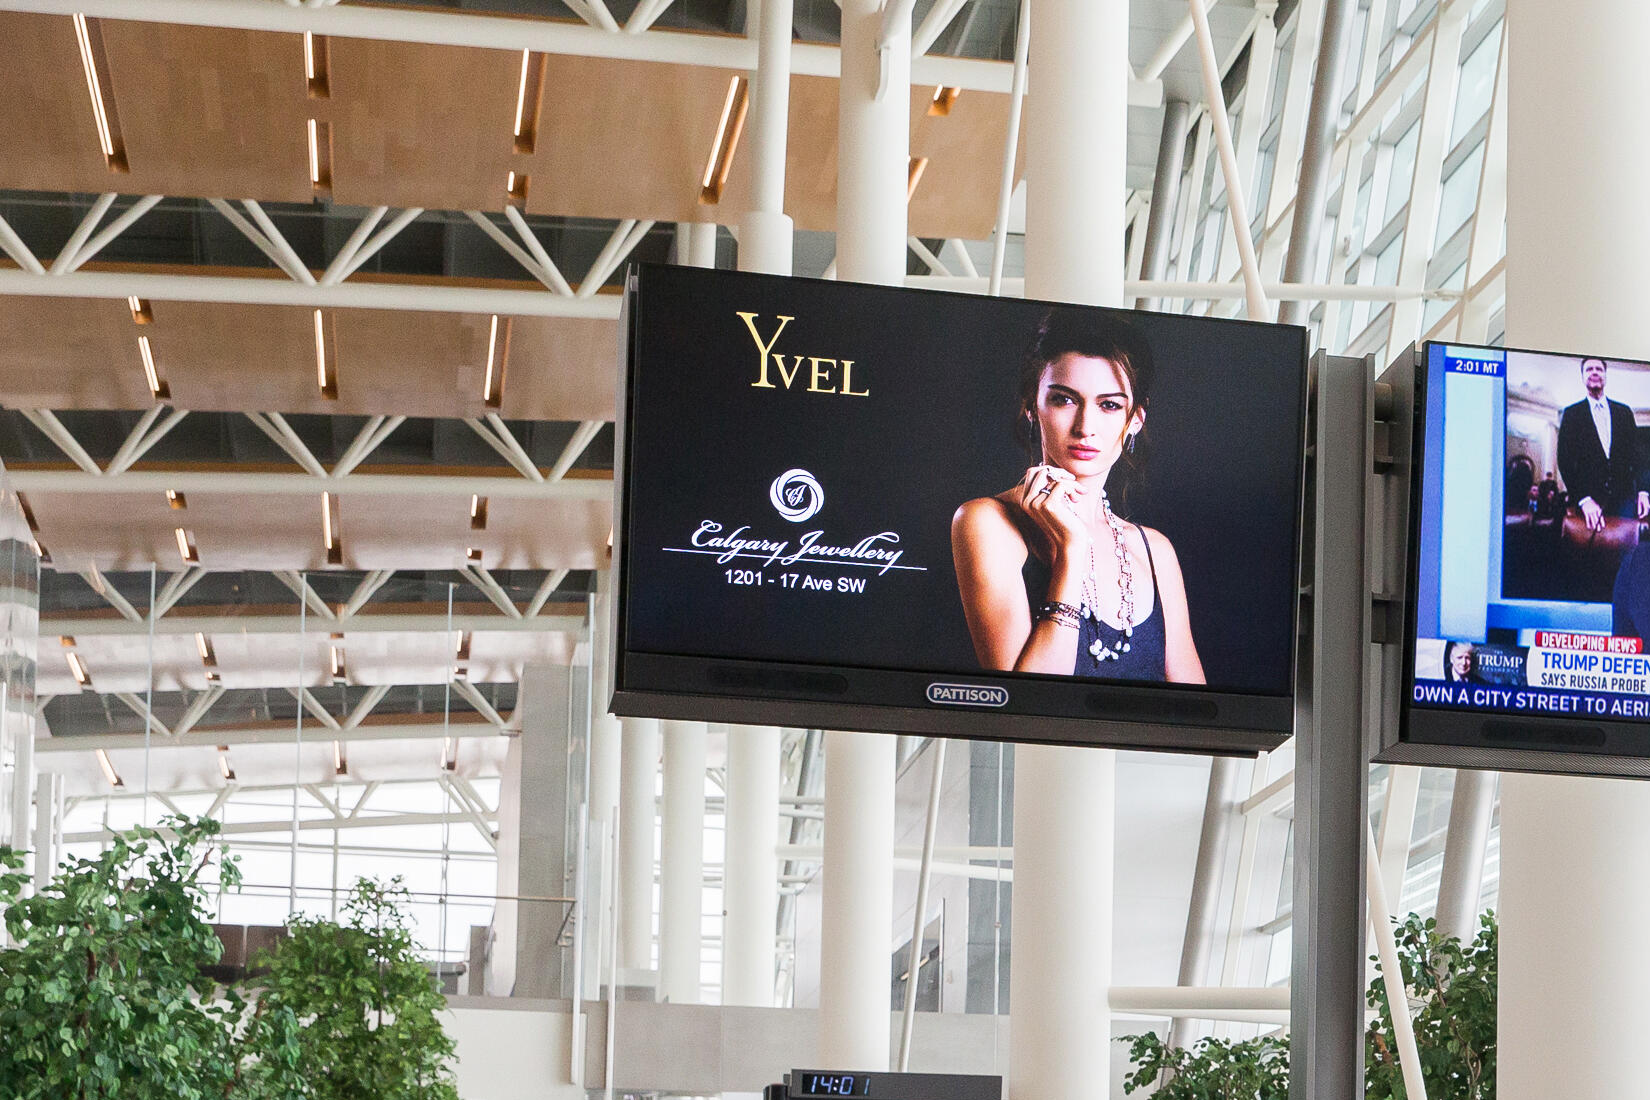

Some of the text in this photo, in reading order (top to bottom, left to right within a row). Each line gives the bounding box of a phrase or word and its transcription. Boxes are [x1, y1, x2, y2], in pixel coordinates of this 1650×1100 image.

[1456, 359, 1499, 375] 2:01 MT
[691, 519, 904, 576] Calgary Jewellery
[725, 568, 763, 586] 1201
[780, 573, 799, 589] 17
[802, 575, 833, 591] Ave
[837, 577, 867, 594] SW
[1541, 631, 1637, 654] DEVELOPING NEWS
[1477, 653, 1524, 669] TRUMP
[1541, 651, 1599, 672] TRUMP
[1541, 672, 1566, 688] SAYS
[1570, 674, 1608, 690] RUSSIA
[1611, 677, 1646, 693] PROBE
[933, 687, 1002, 703] PATTISON
[1414, 685, 1453, 704] OWN
[1457, 687, 1469, 705] A
[1474, 689, 1512, 708] CITY
[1515, 692, 1579, 713] STREET
[1585, 697, 1606, 714] TO
